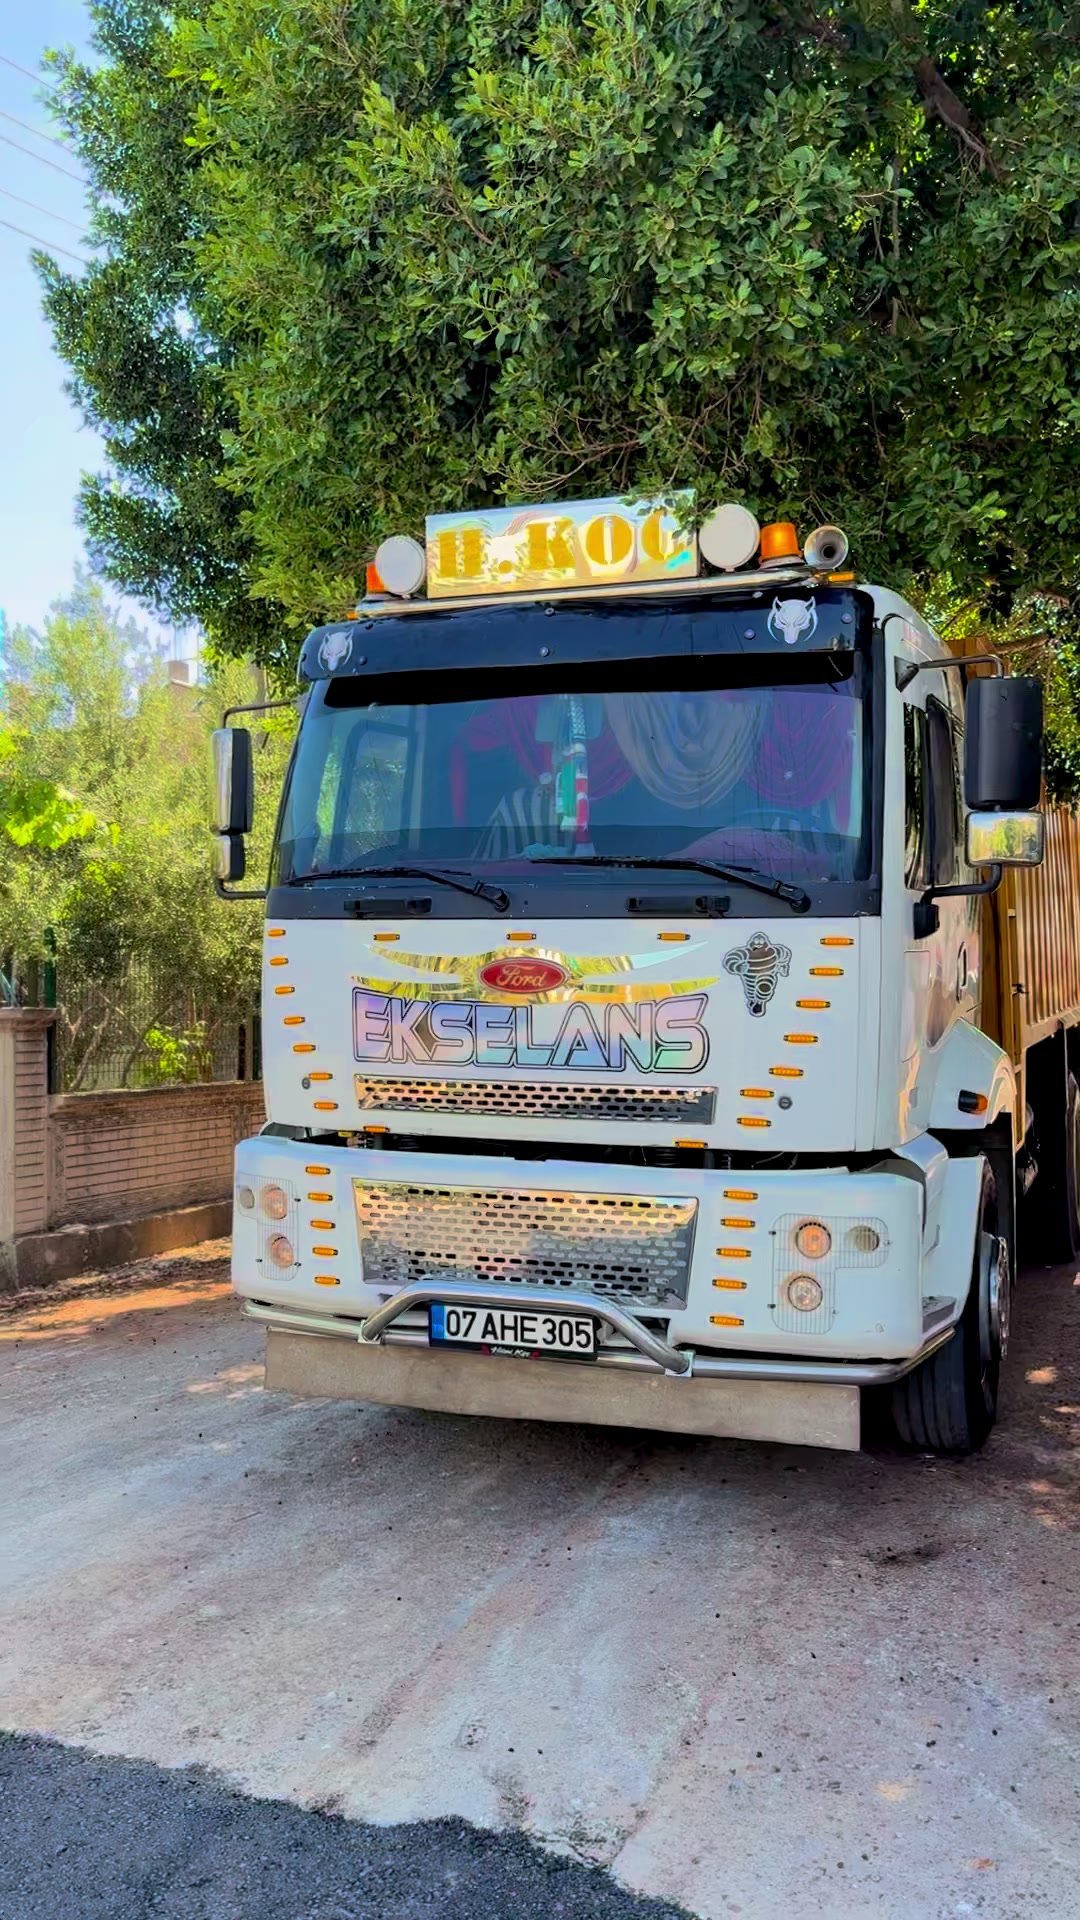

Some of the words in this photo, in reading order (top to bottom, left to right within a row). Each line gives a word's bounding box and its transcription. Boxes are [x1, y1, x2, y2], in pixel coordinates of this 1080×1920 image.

[496, 965, 548, 987] Ford
[352, 986, 709, 1073] EKSELANS
[446, 1310, 477, 1338] 07
[481, 1313, 538, 1344] AHE
[542, 1317, 592, 1349] 305
